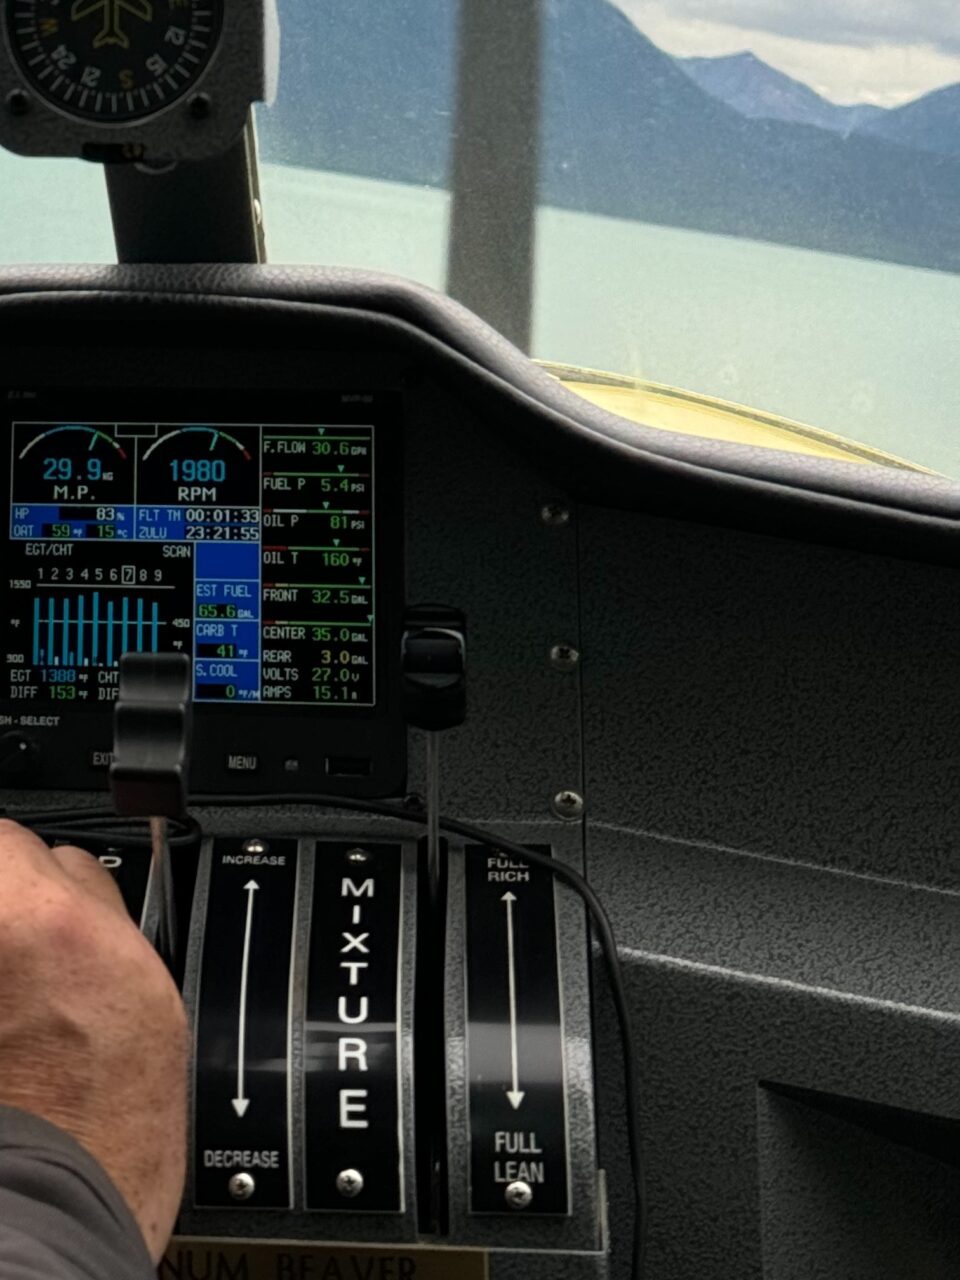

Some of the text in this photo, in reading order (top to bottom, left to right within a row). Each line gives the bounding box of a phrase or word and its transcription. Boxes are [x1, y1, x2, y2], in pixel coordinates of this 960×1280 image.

[38, 17, 59, 38] W
[165, 26, 187, 46] 12
[51, 44, 77, 70] 24
[145, 53, 169, 77] 15
[80, 66, 102, 88] 21
[117, 68, 136, 91] S
[263, 441, 350, 455] F.FLOW 30.6
[43, 458, 102, 481] 29.9
[169, 459, 227, 482] 1980
[53, 485, 96, 500] M.P.
[263, 478, 365, 493] FUEL P 5.4 PSI
[177, 486, 217, 502] RPM
[14, 507, 115, 521] HP 83
[138, 509, 259, 523] FLT TM 00:01:33
[263, 514, 365, 531] OIL P 81 PSI
[13, 524, 115, 538] OAT 59 15
[138, 526, 259, 540] ZULU 23:21:55
[25, 543, 191, 558] EGT/CHT SCAN
[263, 552, 350, 566] OIL T 160
[37, 567, 162, 581] 1 2 3 4 5 6 7 8 9
[9, 579, 32, 589] 1550
[196, 584, 252, 598] EST FUEL
[263, 589, 299, 602] FRONT
[312, 590, 350, 604] 32.5
[198, 604, 236, 618] 65.6
[172, 618, 190, 628] 450
[196, 624, 238, 637] CARB T
[263, 626, 306, 640] CENTER
[312, 628, 350, 641] 35.0
[216, 644, 234, 657] 41
[263, 650, 368, 665] REAR 3.0 GAL
[10, 669, 119, 683] EGT 1388 CHT
[196, 664, 238, 677] S.COOL
[263, 668, 350, 682] VOLTS 27.0
[10, 685, 76, 699] DIFF 153
[226, 685, 235, 698] 0
[263, 686, 349, 700] AMPS 15.1
[227, 755, 257, 770] MENU
[221, 854, 287, 866] INCREASE
[486, 857, 530, 869] FULL
[486, 870, 530, 884] RICH
[337, 876, 376, 1130] MIXTURE
[493, 1130, 543, 1155] FULL
[203, 1149, 280, 1169] DECREASE
[493, 1159, 545, 1184] LEAN
[275, 1251, 418, 1280] BEAVER
